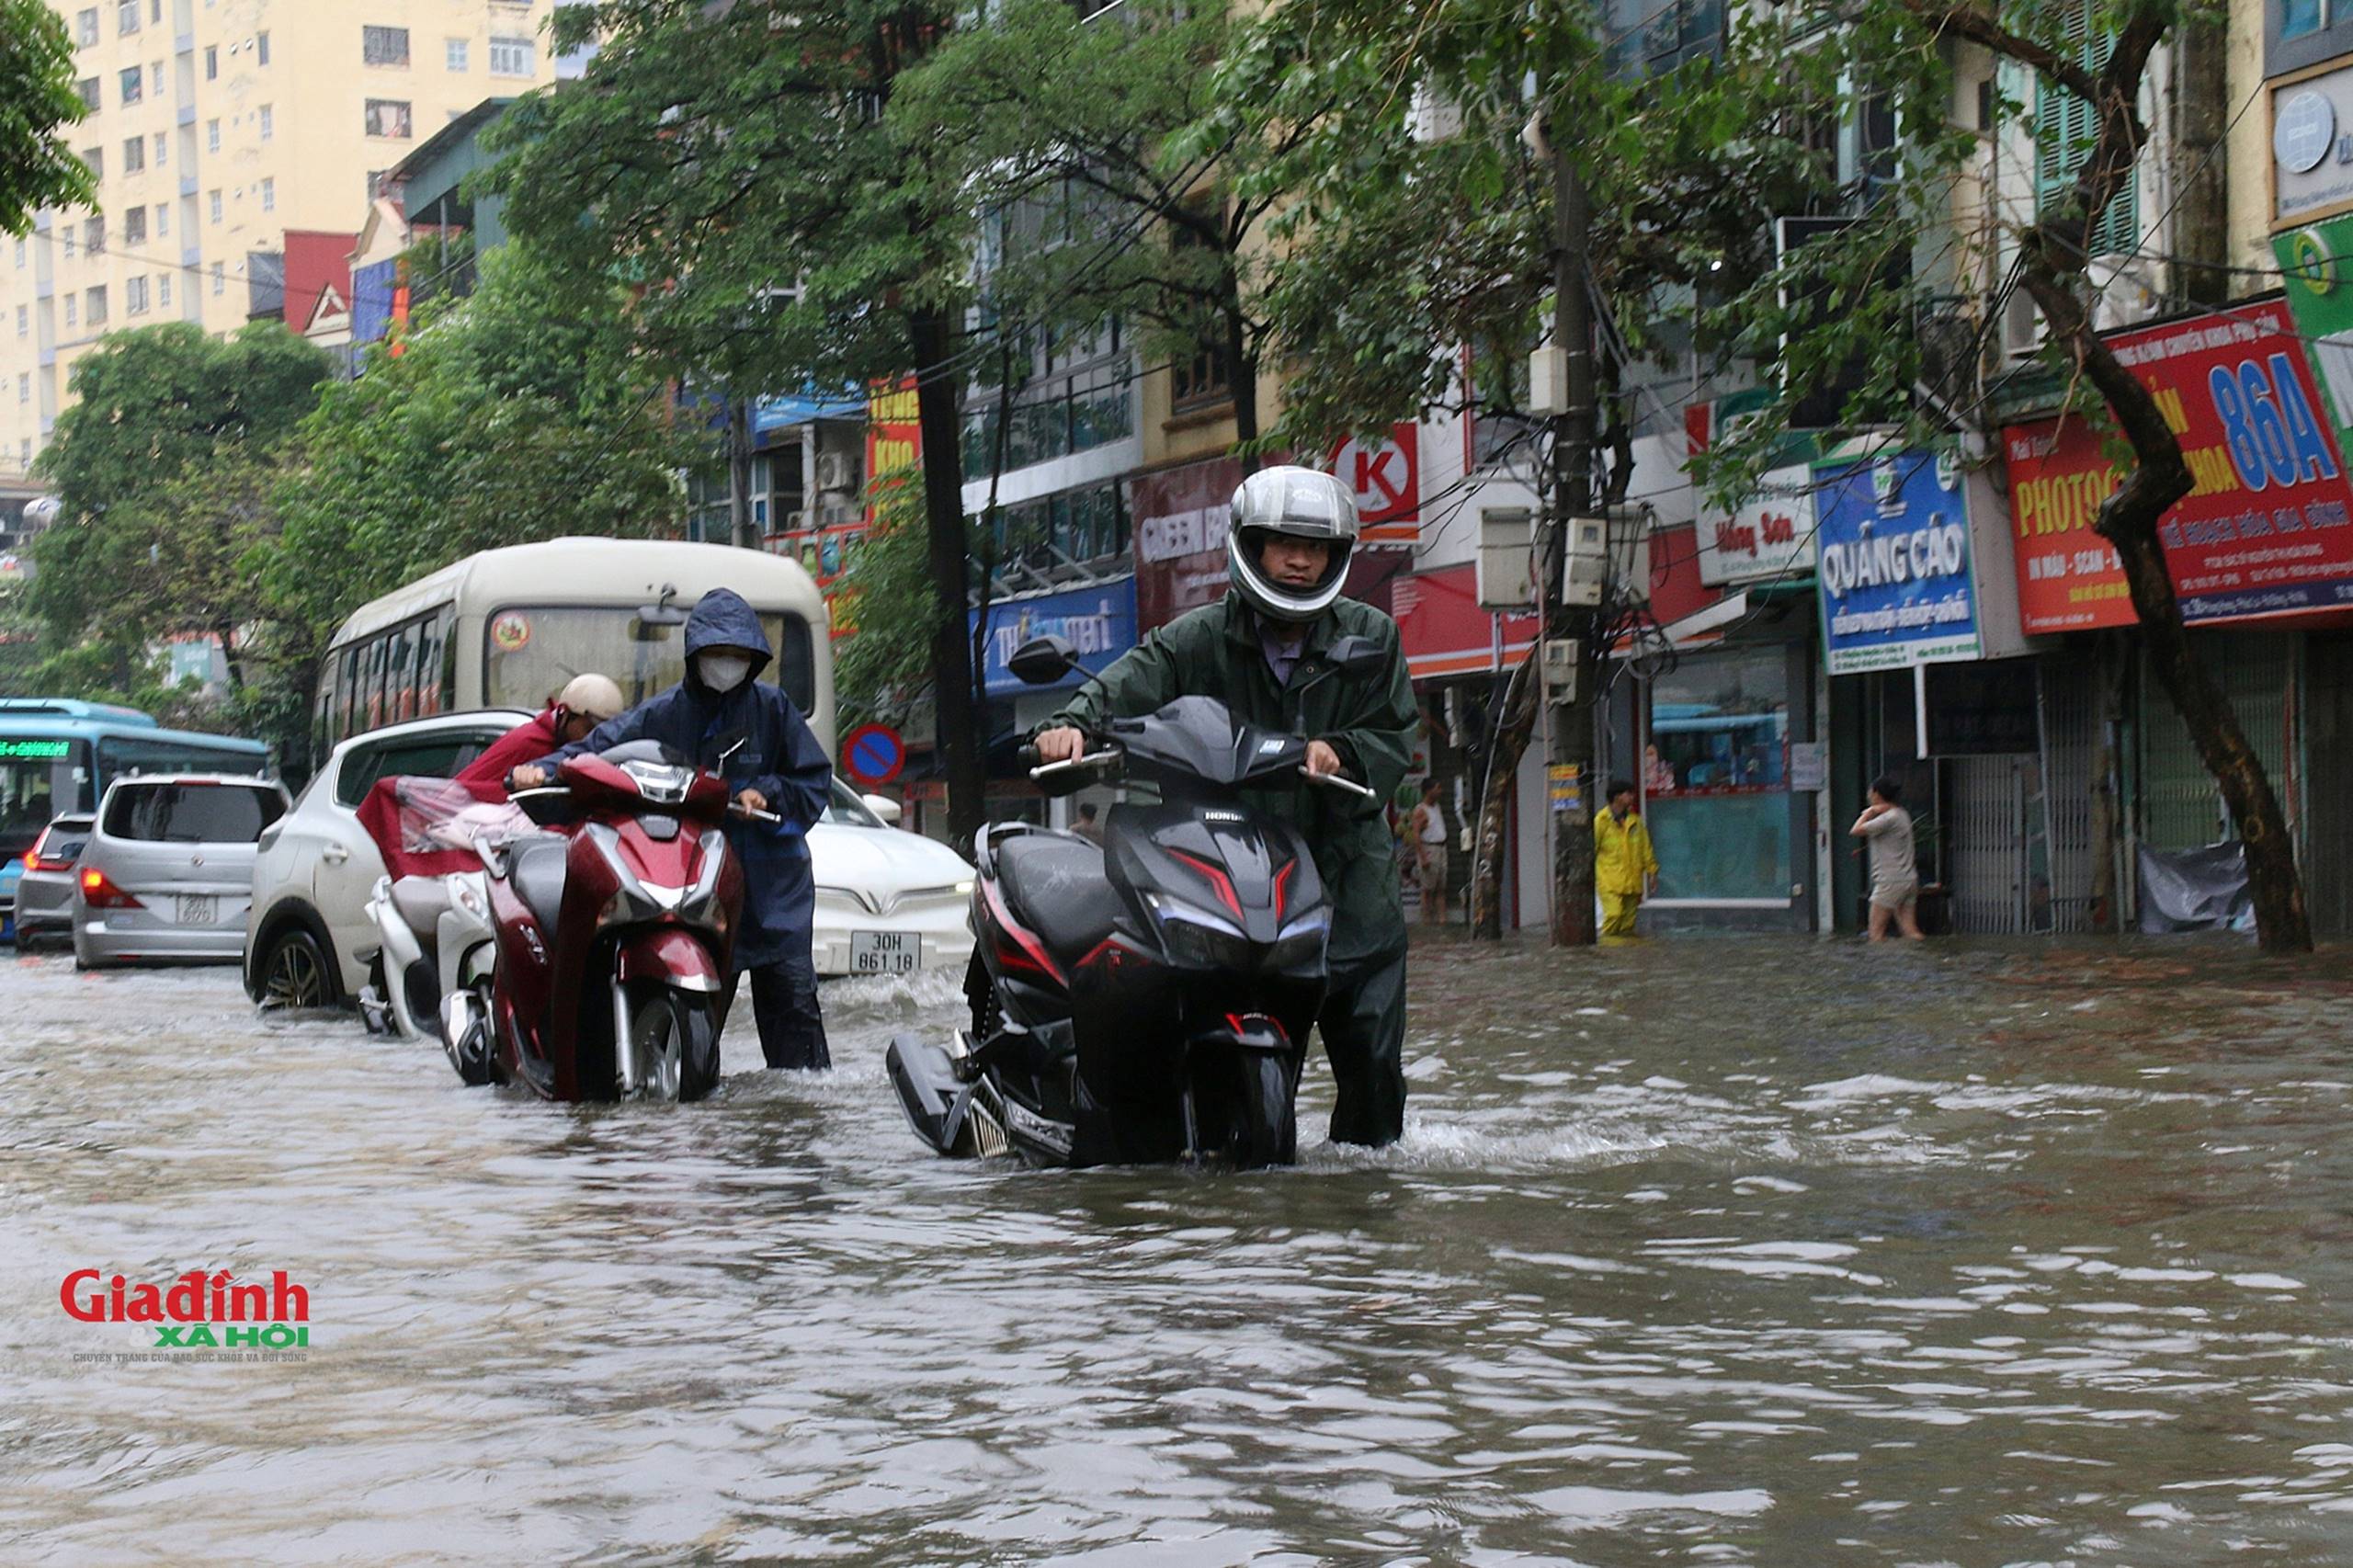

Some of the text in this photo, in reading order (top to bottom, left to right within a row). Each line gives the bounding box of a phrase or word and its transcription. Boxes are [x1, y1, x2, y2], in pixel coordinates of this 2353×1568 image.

[2209, 351, 2340, 492] 86A
[1824, 513, 1964, 598] QUẢNG CÁO
[858, 952, 913, 971] 861.18
[872, 933, 902, 951] 30H
